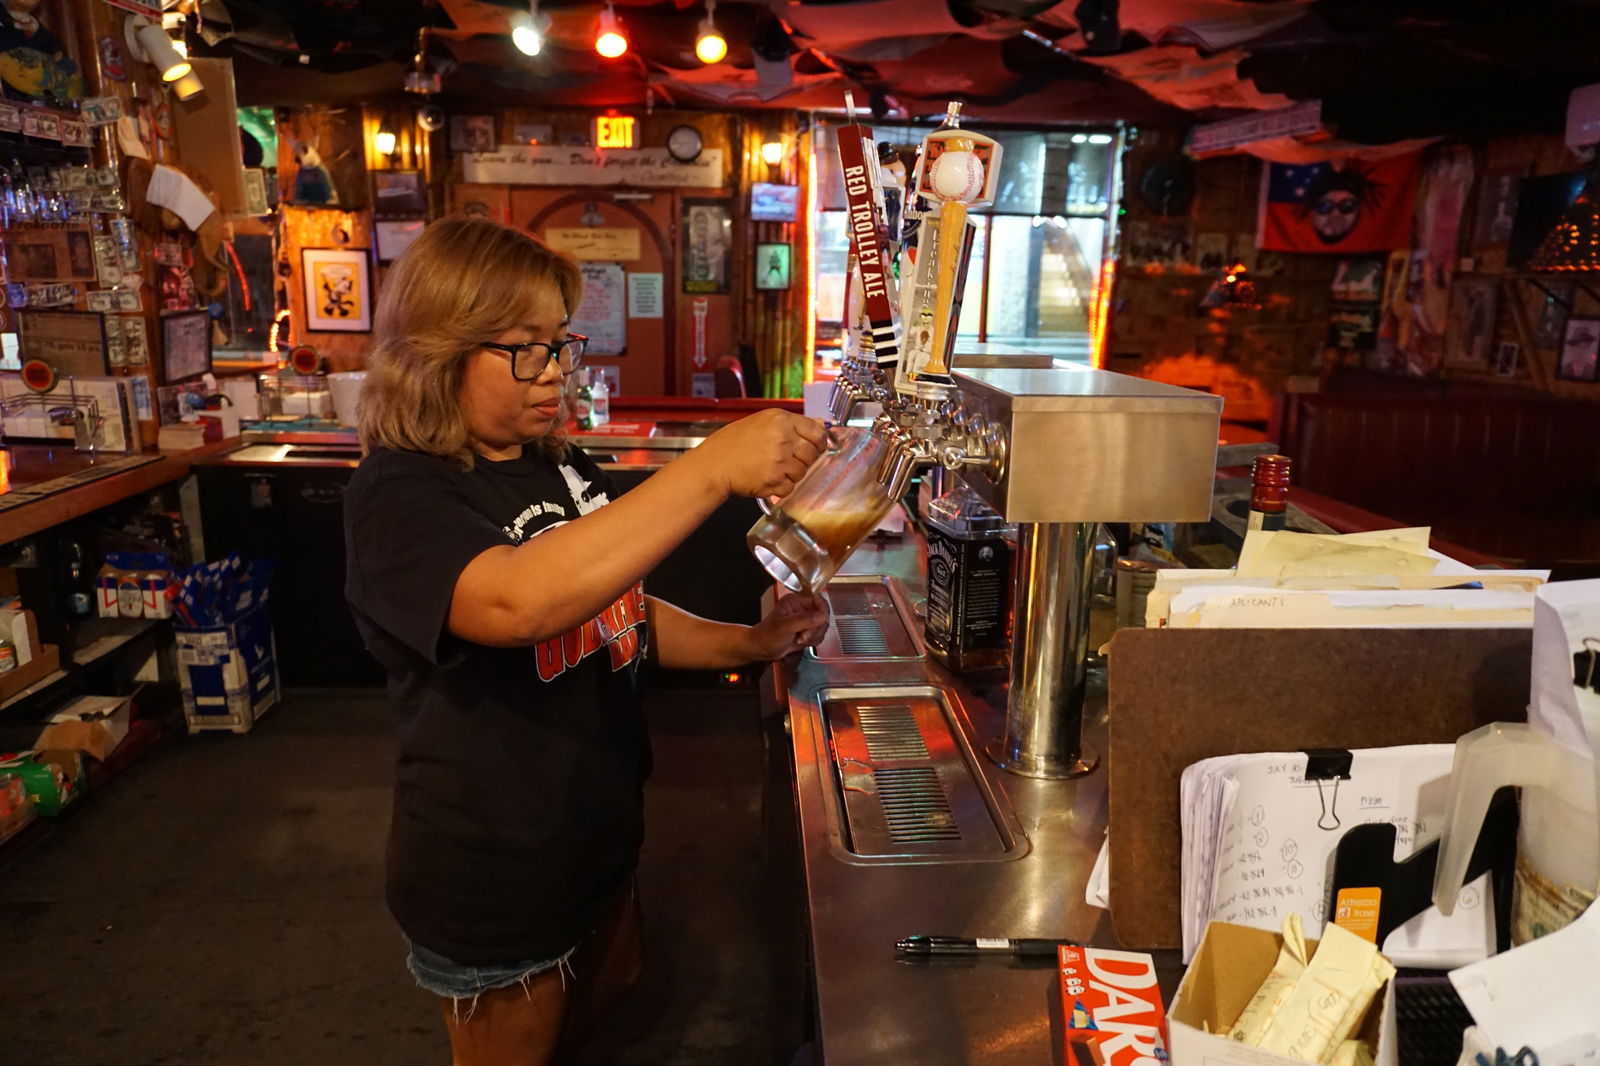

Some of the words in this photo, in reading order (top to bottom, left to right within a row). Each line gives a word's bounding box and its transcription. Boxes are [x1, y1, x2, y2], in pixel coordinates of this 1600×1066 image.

[597, 116, 635, 148] EXIT
[511, 150, 527, 164] the
[844, 165, 868, 196] RED
[851, 200, 880, 265] TROLLEY
[863, 271, 885, 299] ALE
